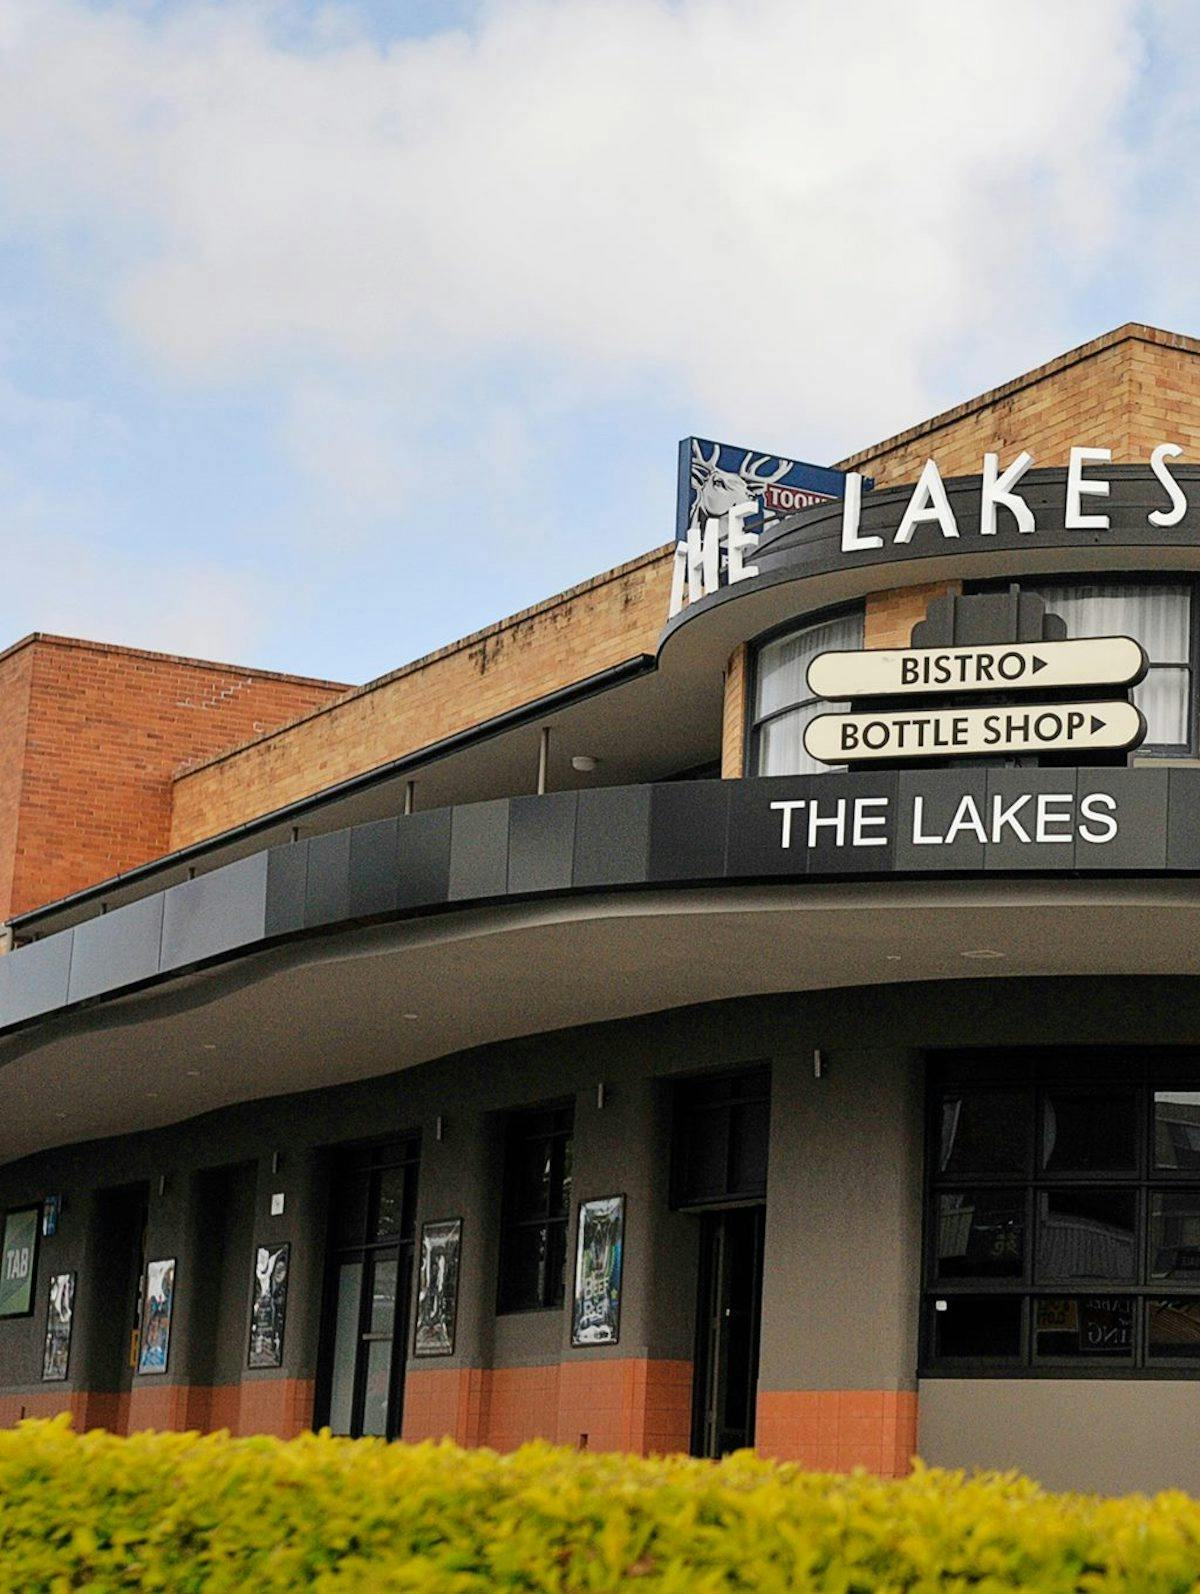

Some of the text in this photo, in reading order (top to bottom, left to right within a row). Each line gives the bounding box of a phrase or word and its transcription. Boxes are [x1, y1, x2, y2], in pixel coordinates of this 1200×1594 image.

[842, 443, 1187, 552] LAKES
[901, 651, 1026, 685] BISTRO
[840, 711, 1085, 751] BOTTLE SHOP
[770, 793, 1119, 849] THE LAKES
[6, 1248, 29, 1280] TAB
